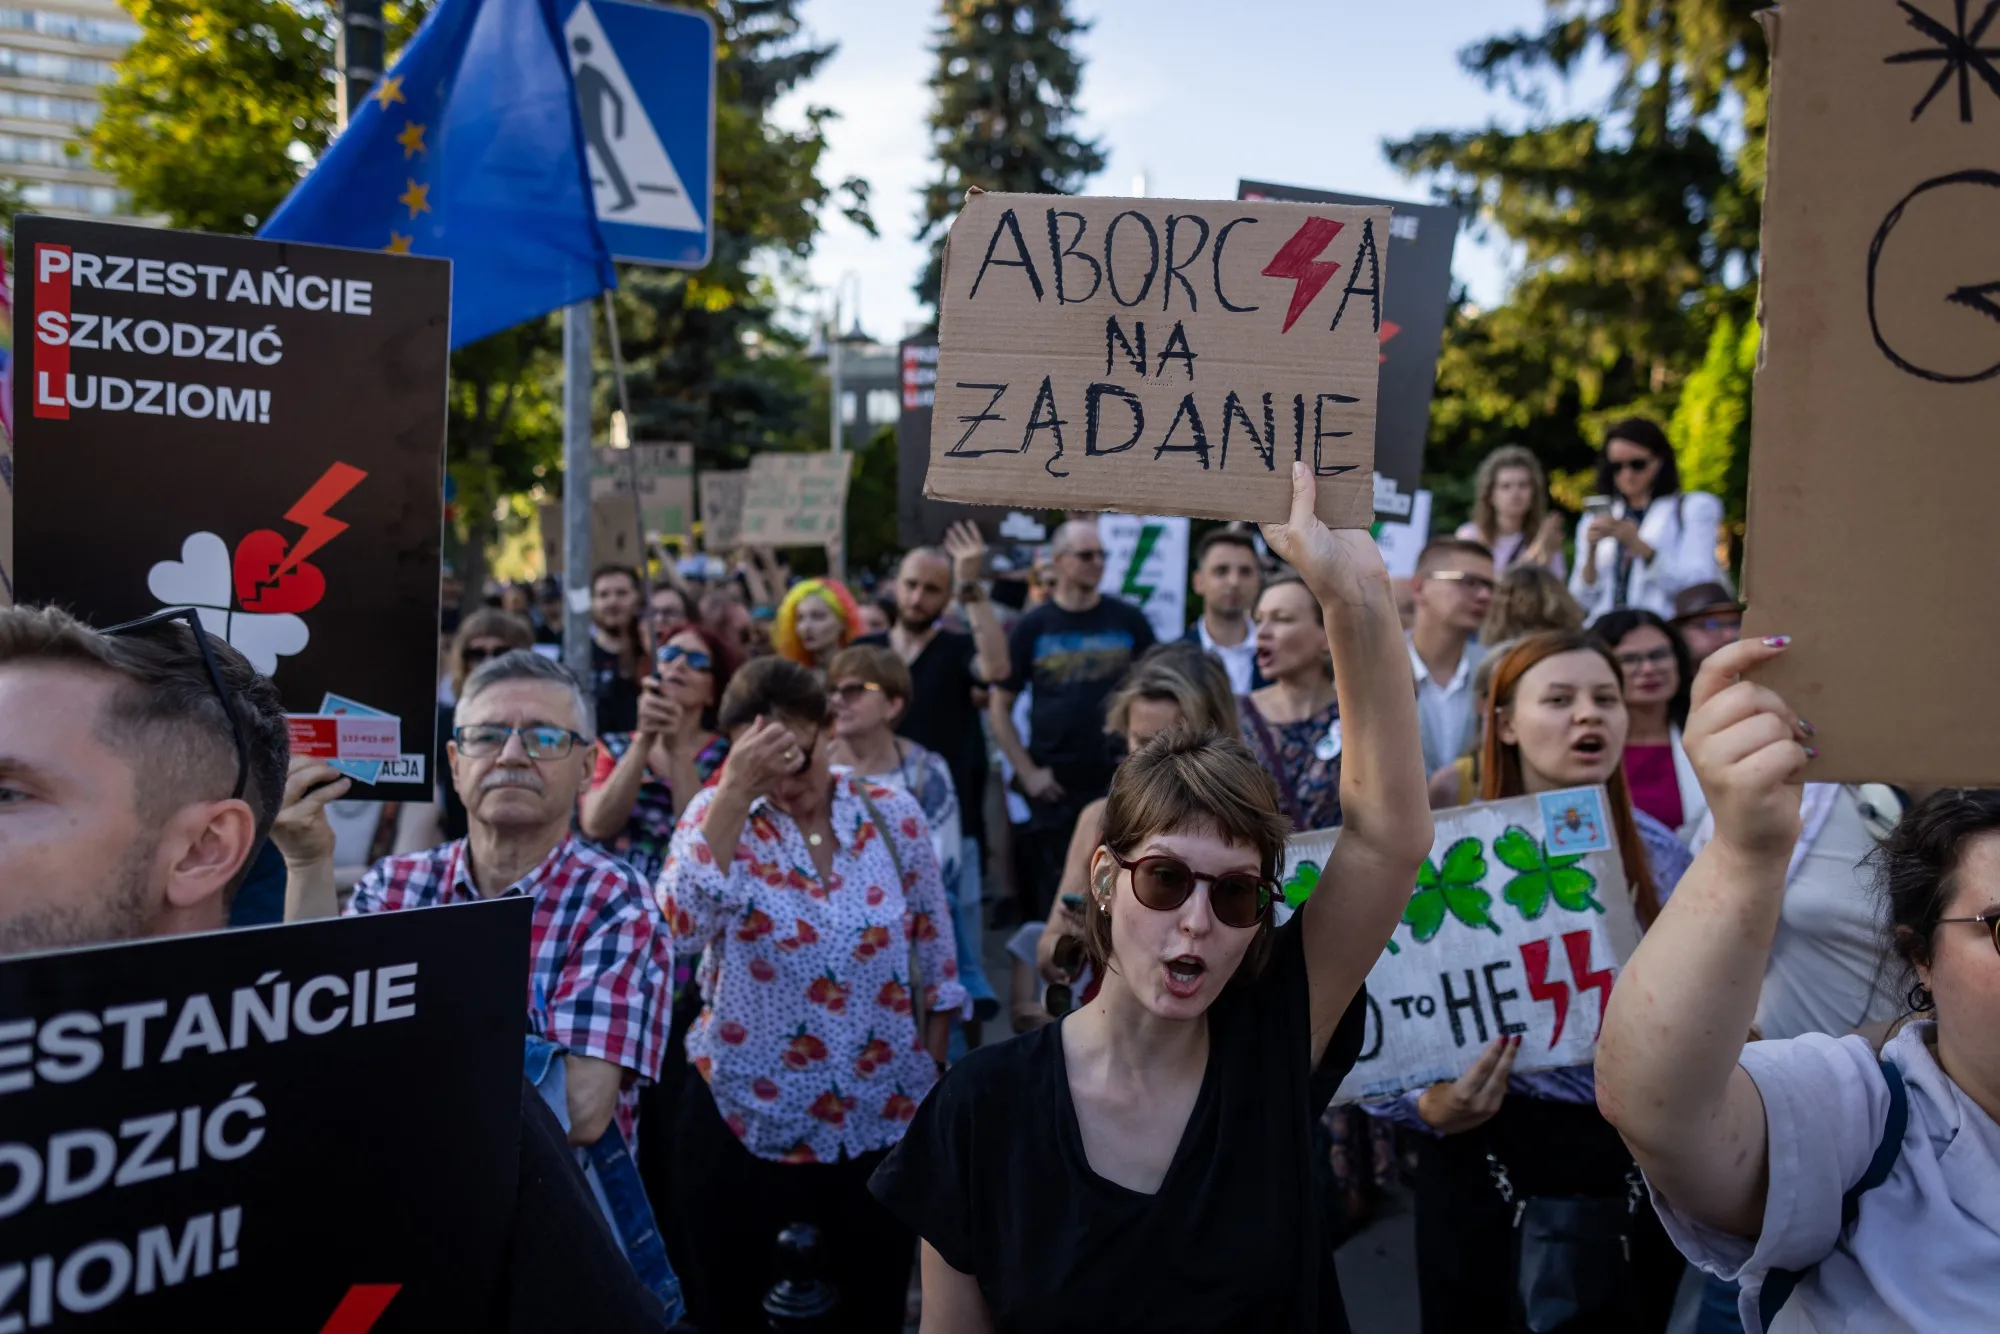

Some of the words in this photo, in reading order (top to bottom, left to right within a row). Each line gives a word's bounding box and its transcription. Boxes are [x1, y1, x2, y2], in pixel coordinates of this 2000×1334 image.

[38, 248, 373, 315] PRZESTAŃCIE
[37, 310, 283, 365] SZKODZIĆ
[1105, 315, 1199, 381] NA
[38, 371, 272, 424] LUDZIOM!
